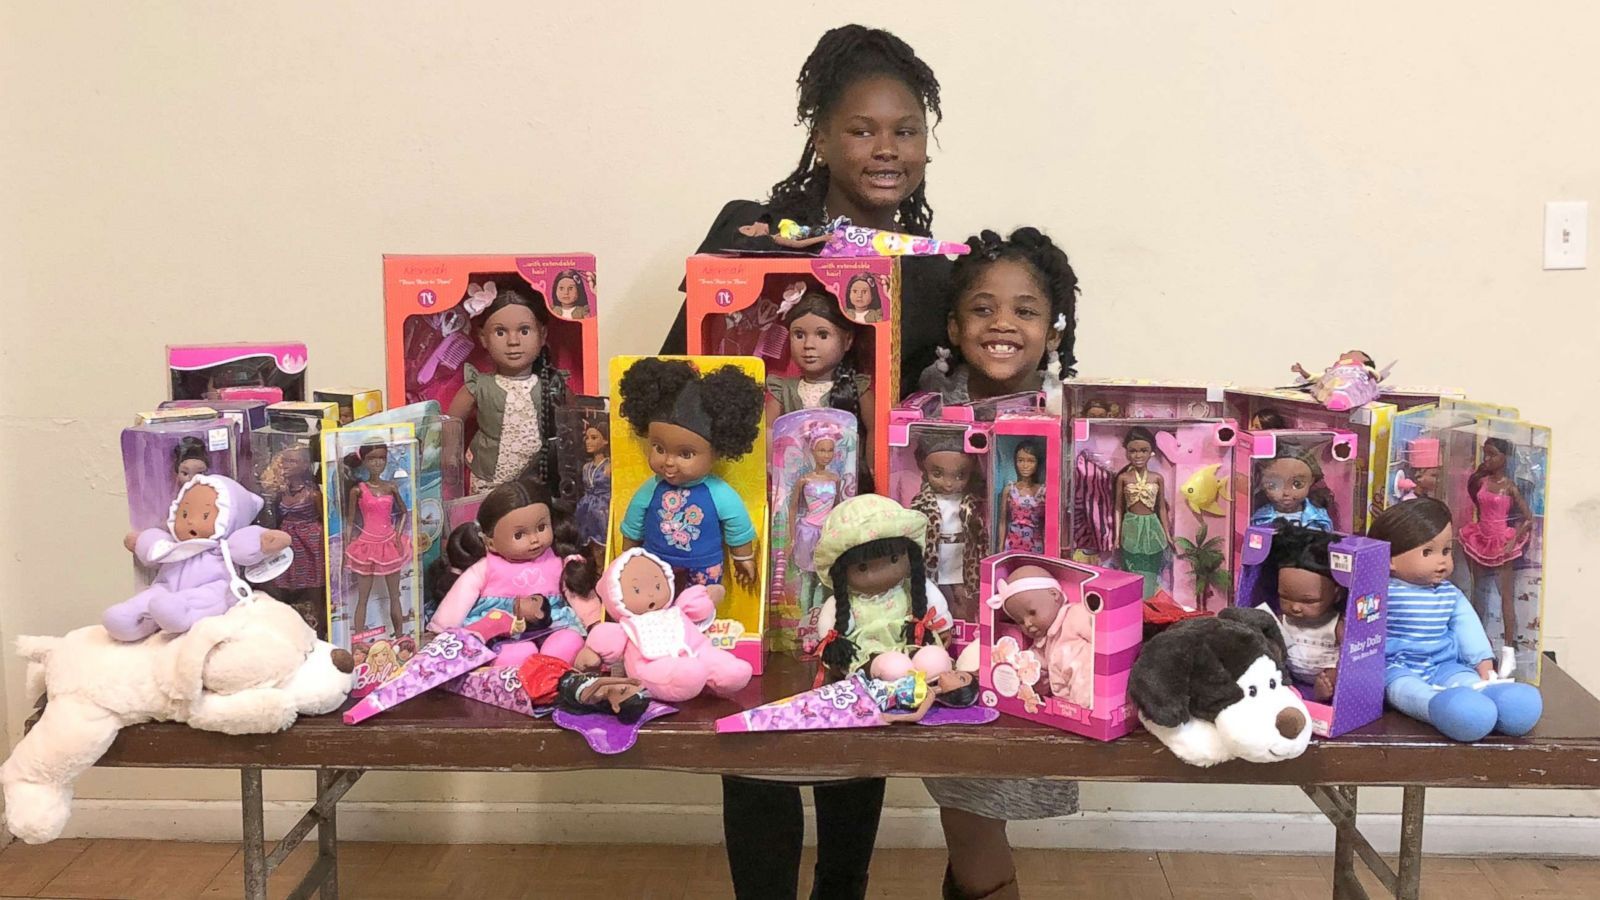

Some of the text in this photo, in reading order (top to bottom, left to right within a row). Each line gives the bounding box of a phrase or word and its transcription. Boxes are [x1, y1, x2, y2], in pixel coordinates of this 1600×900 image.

[542, 259, 576, 267] extendable
[836, 260, 870, 269] extendable
[1356, 597, 1381, 615] PLAY
[1350, 633, 1382, 654] Baby Dolls
[353, 662, 397, 689] Barb
[985, 695, 994, 704] 2+
